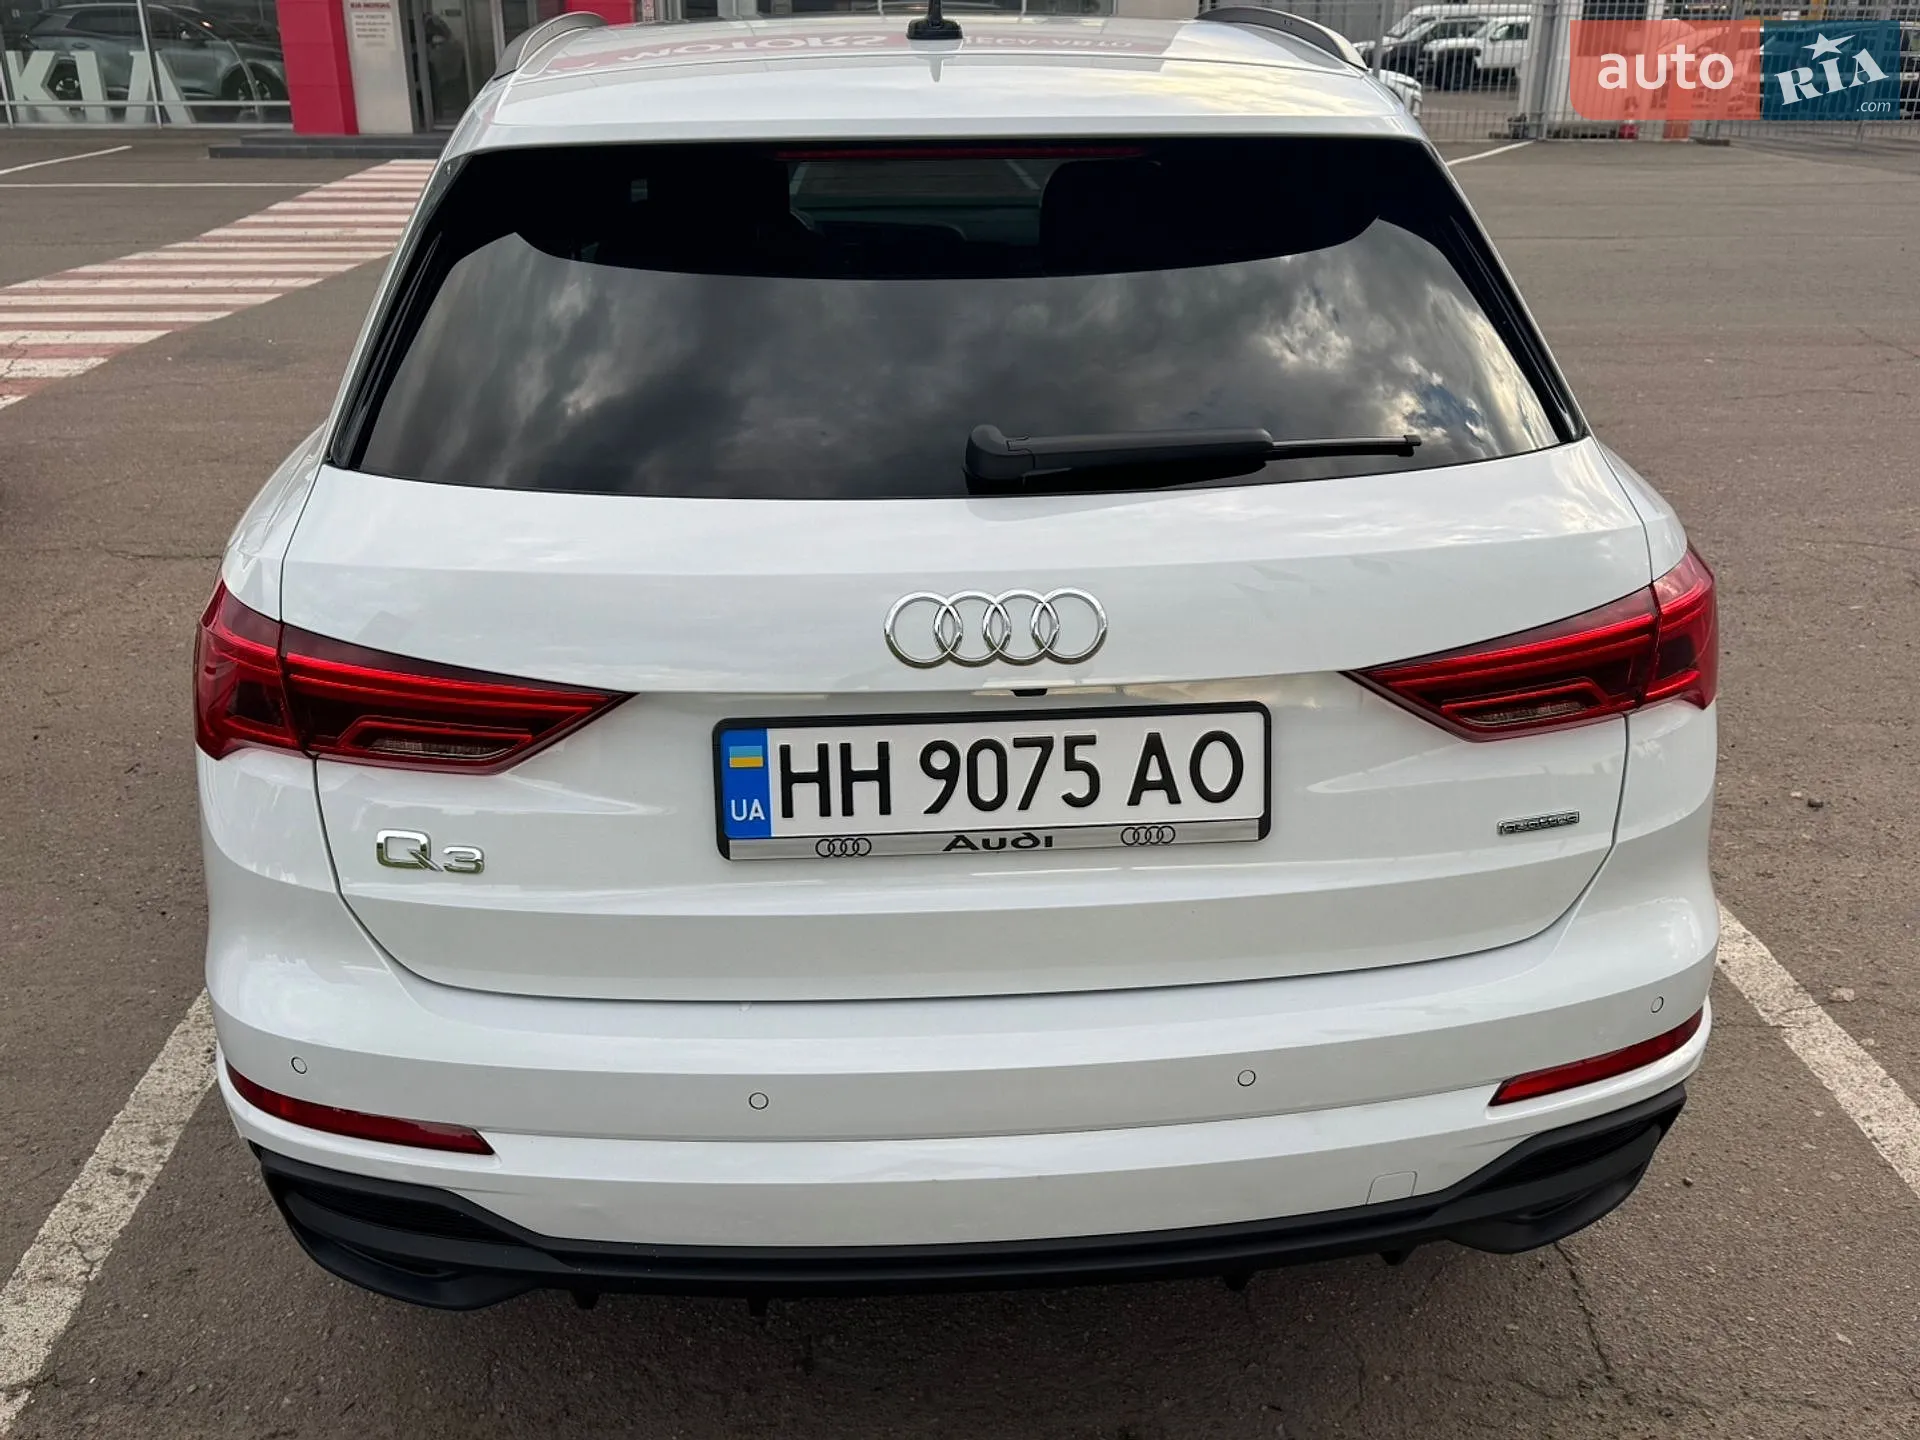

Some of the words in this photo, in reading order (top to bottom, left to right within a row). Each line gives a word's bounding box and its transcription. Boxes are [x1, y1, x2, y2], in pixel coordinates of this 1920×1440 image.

[5, 50, 195, 124] KIA
[779, 741, 892, 819] HH
[918, 734, 1100, 814] 9075
[1127, 729, 1245, 808] AO
[731, 799, 766, 822] UA
[376, 829, 485, 873] Q3
[942, 834, 1054, 853] Audi
